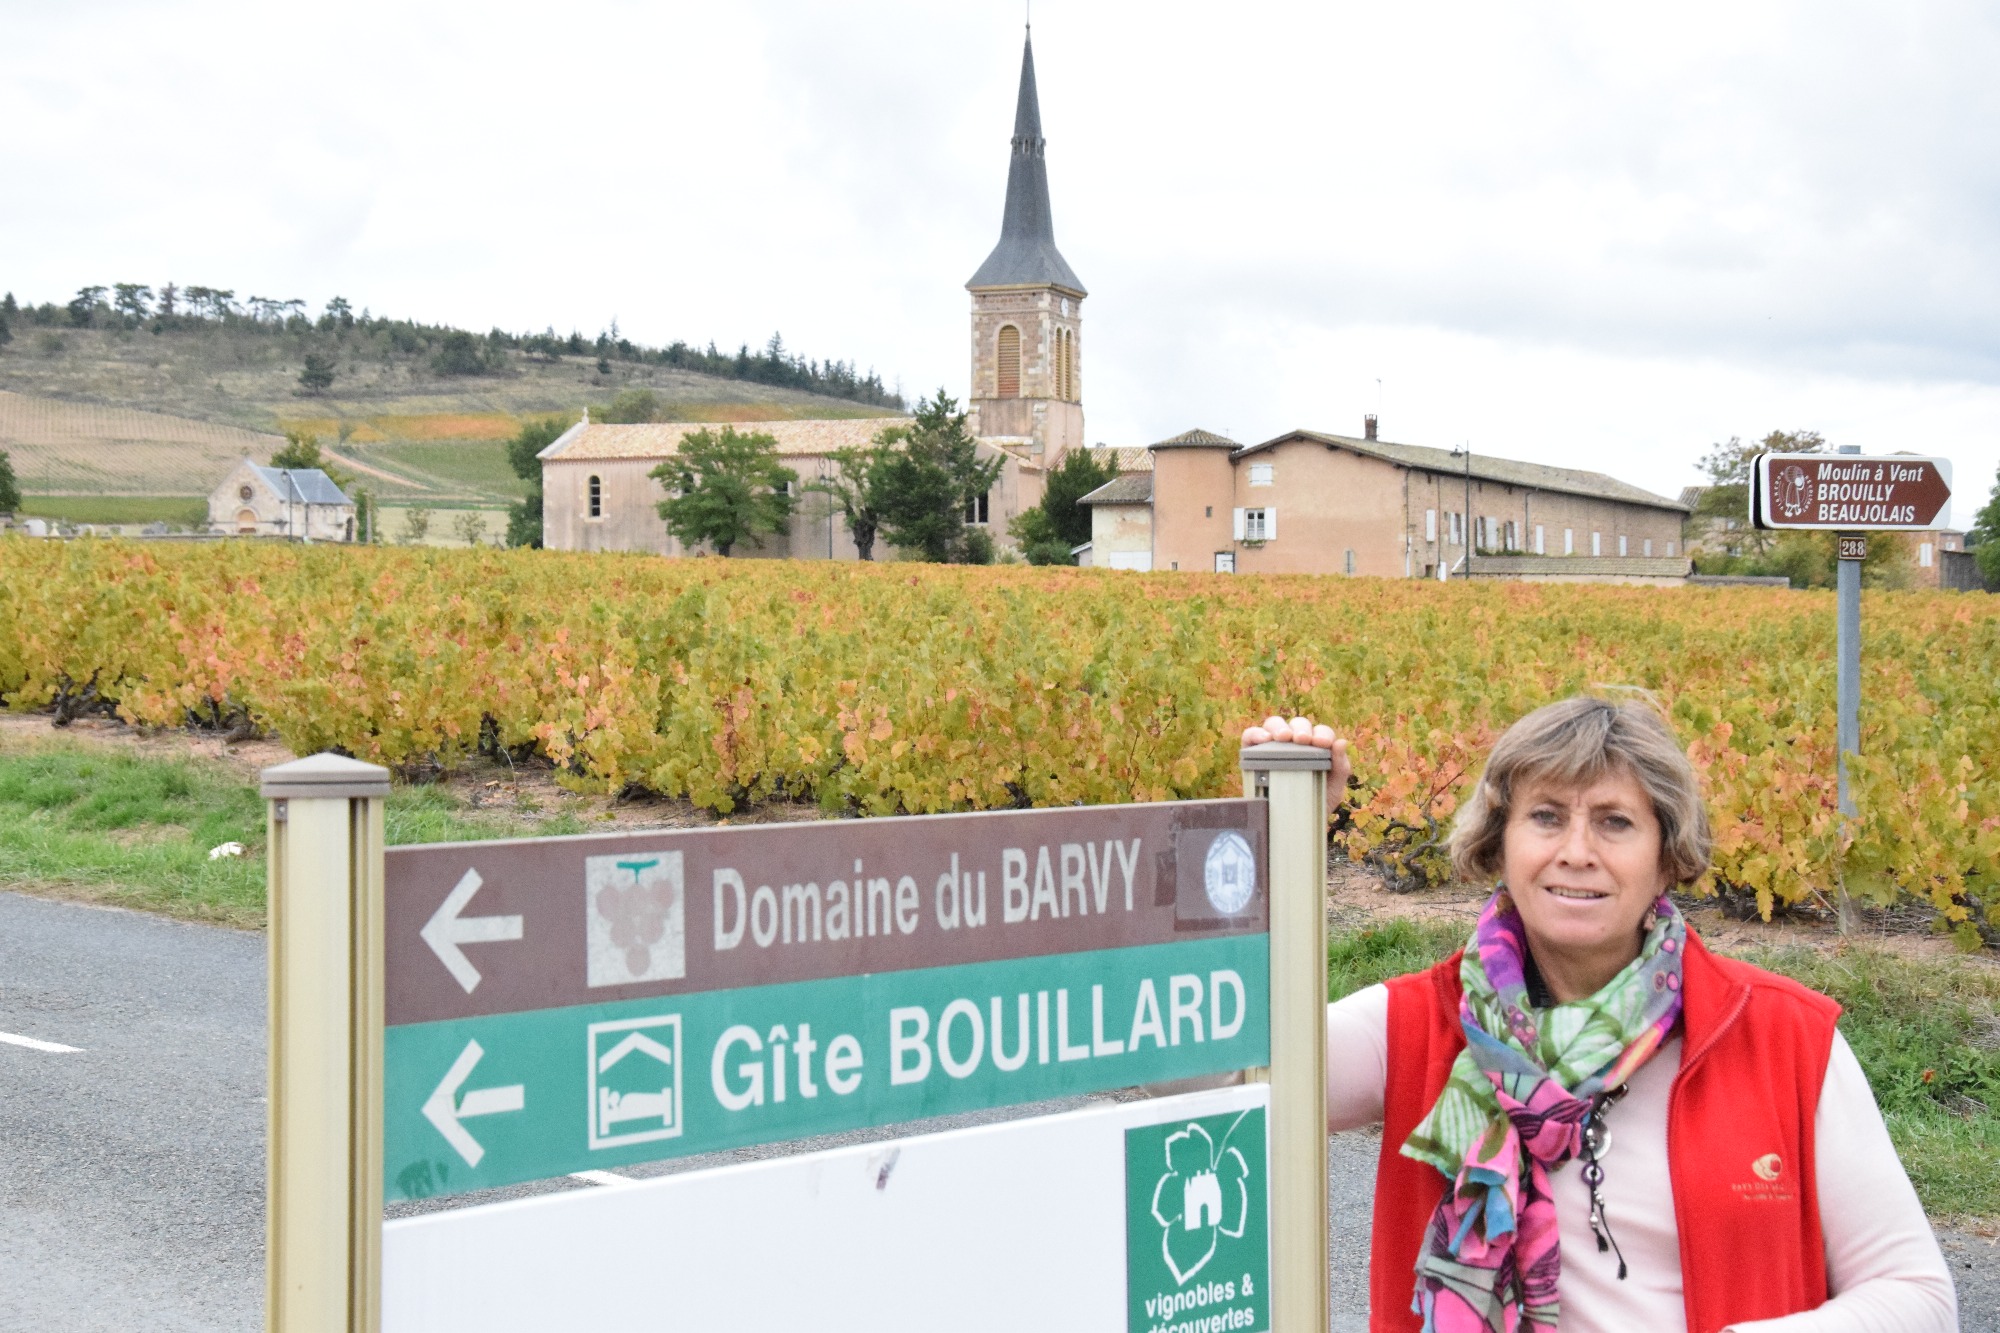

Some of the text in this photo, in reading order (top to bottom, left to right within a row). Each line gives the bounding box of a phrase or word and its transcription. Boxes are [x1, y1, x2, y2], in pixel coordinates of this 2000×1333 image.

[1817, 463, 1923, 482] Moulin à Vent
[1817, 483, 1894, 501] BROUILLY
[1818, 504, 1915, 522] BEAUJOLAIS
[1841, 540, 1865, 556] 288
[712, 859, 919, 950] Domaine
[935, 852, 986, 931] du
[1002, 838, 1142, 923] BARVY
[711, 969, 1246, 1111] Gîte BOUILLARD
[1145, 1273, 1254, 1321] vignobles &
